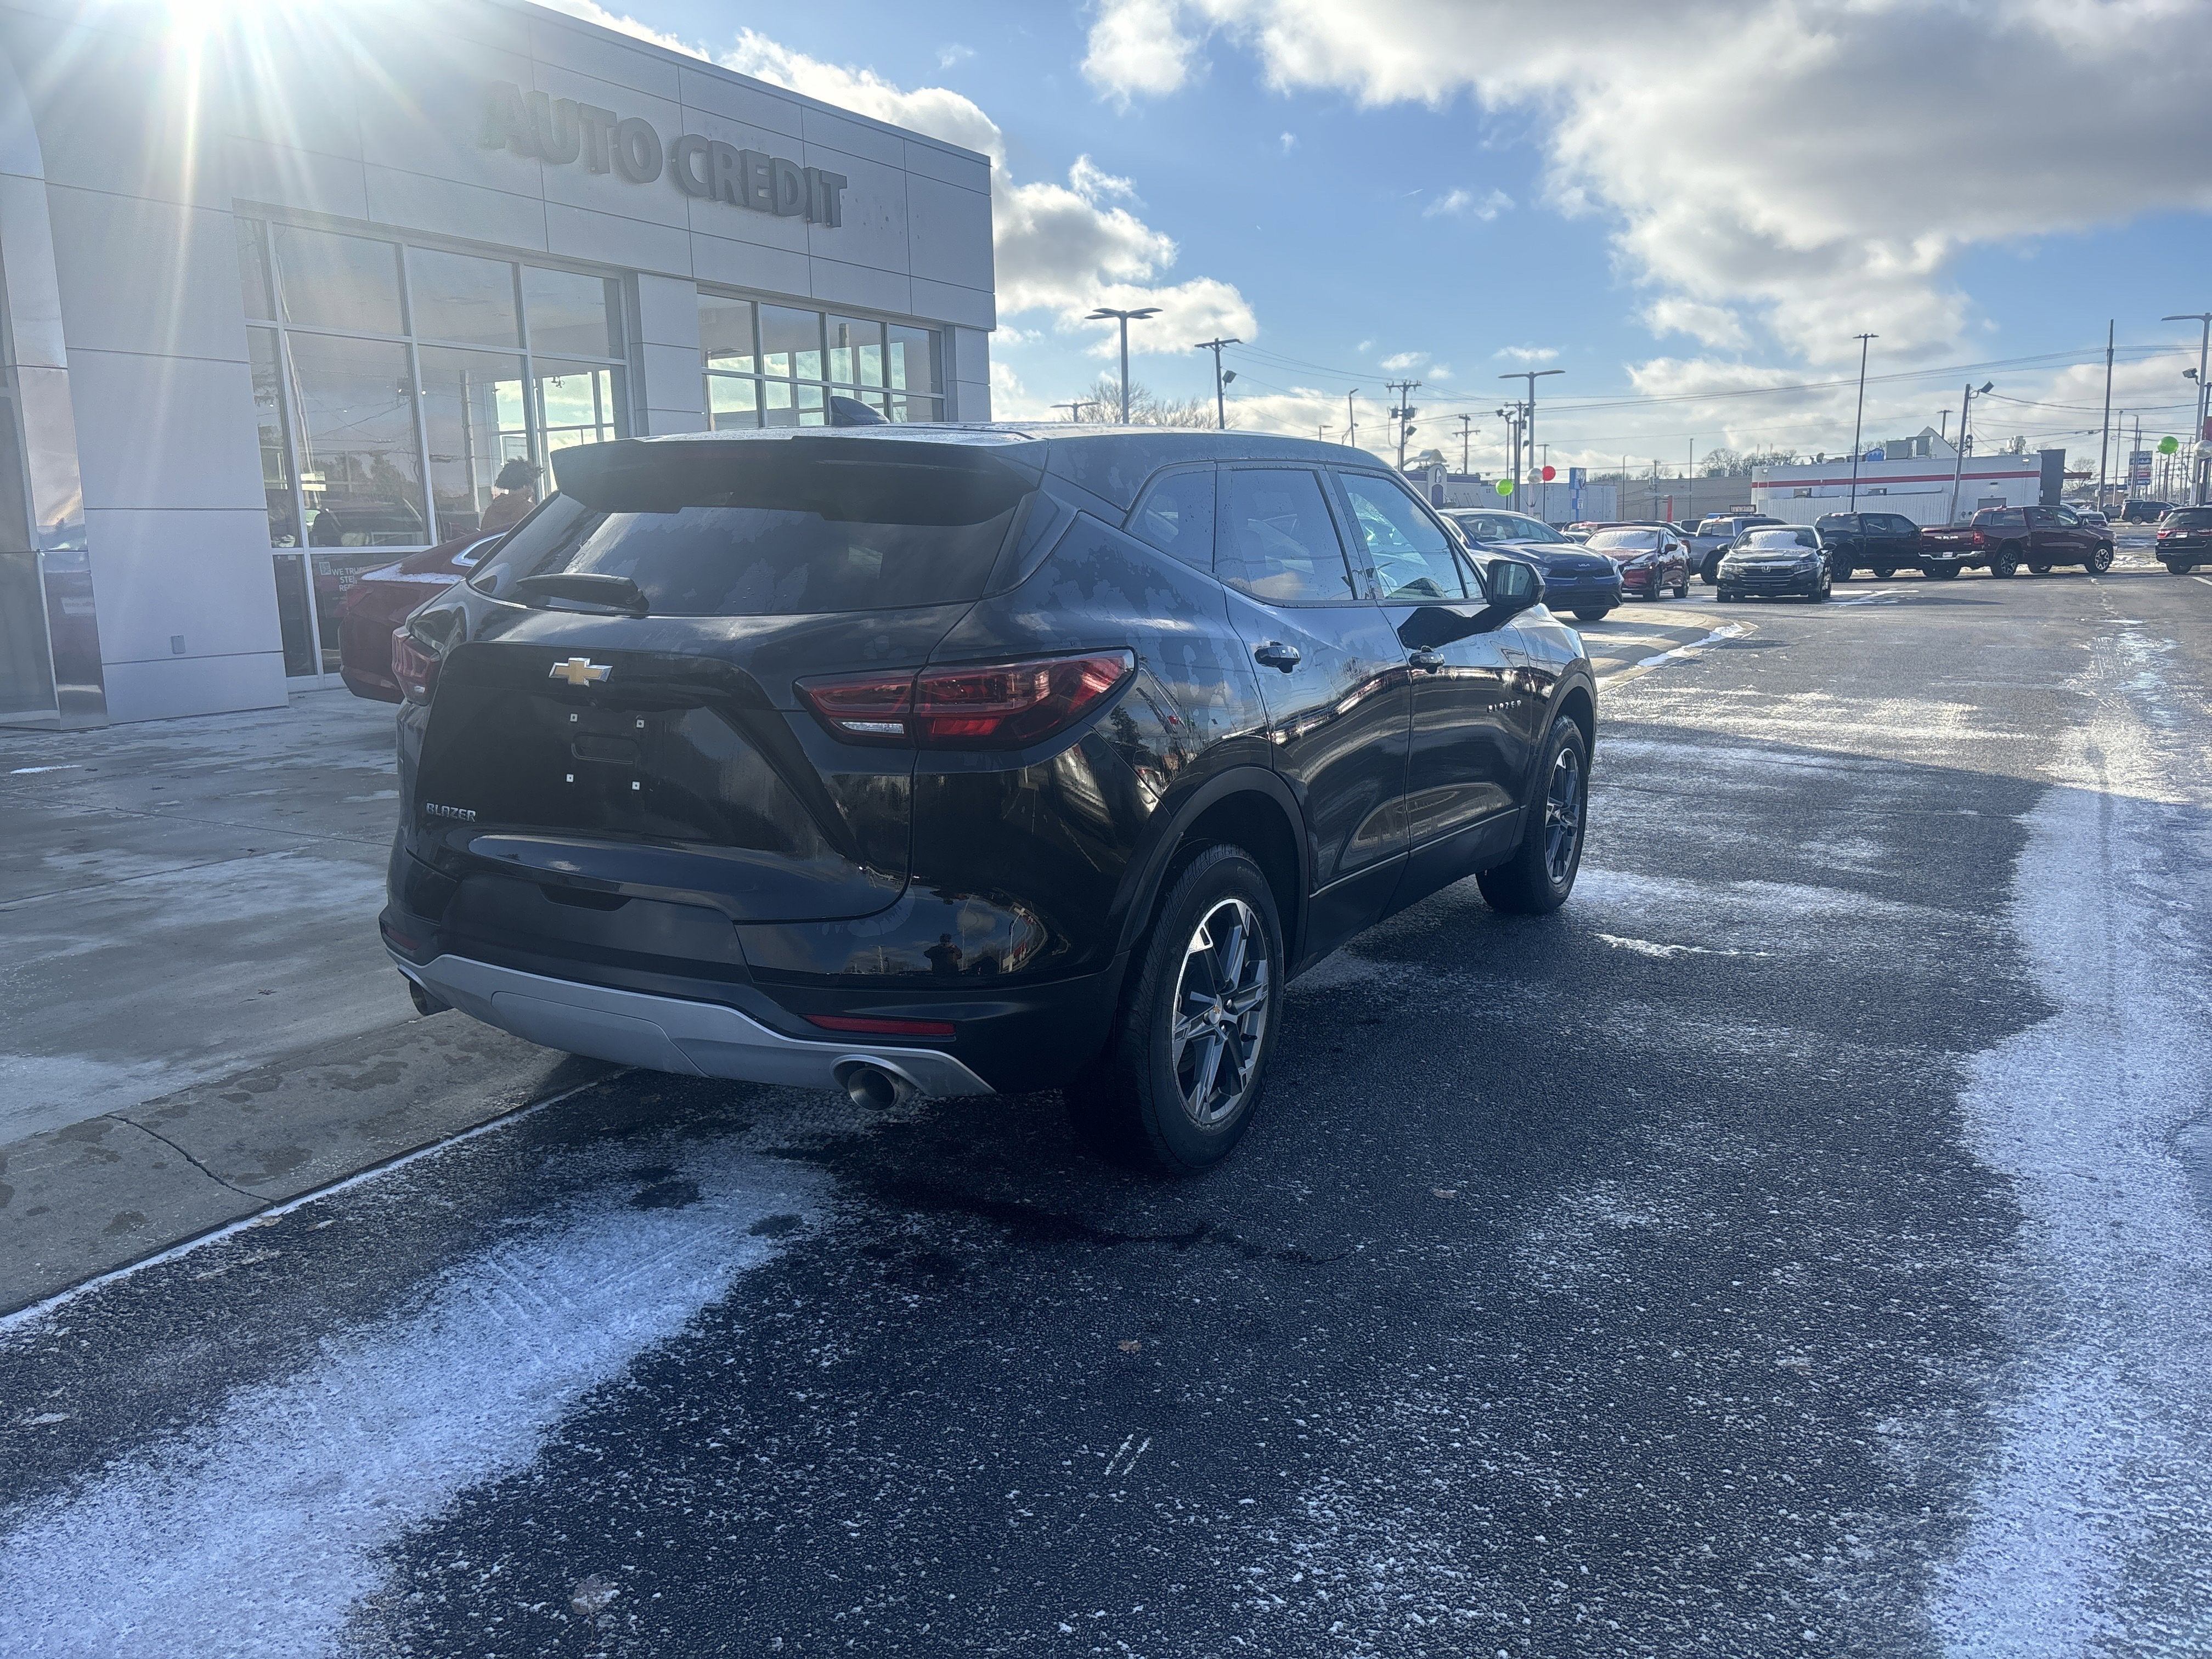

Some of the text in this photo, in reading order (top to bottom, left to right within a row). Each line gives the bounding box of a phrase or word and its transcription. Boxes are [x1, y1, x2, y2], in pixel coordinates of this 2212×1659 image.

[480, 81, 848, 228] AUTO CREDIT
[1487, 699, 1522, 713] BLAZER
[426, 803, 477, 822] BLAZER
